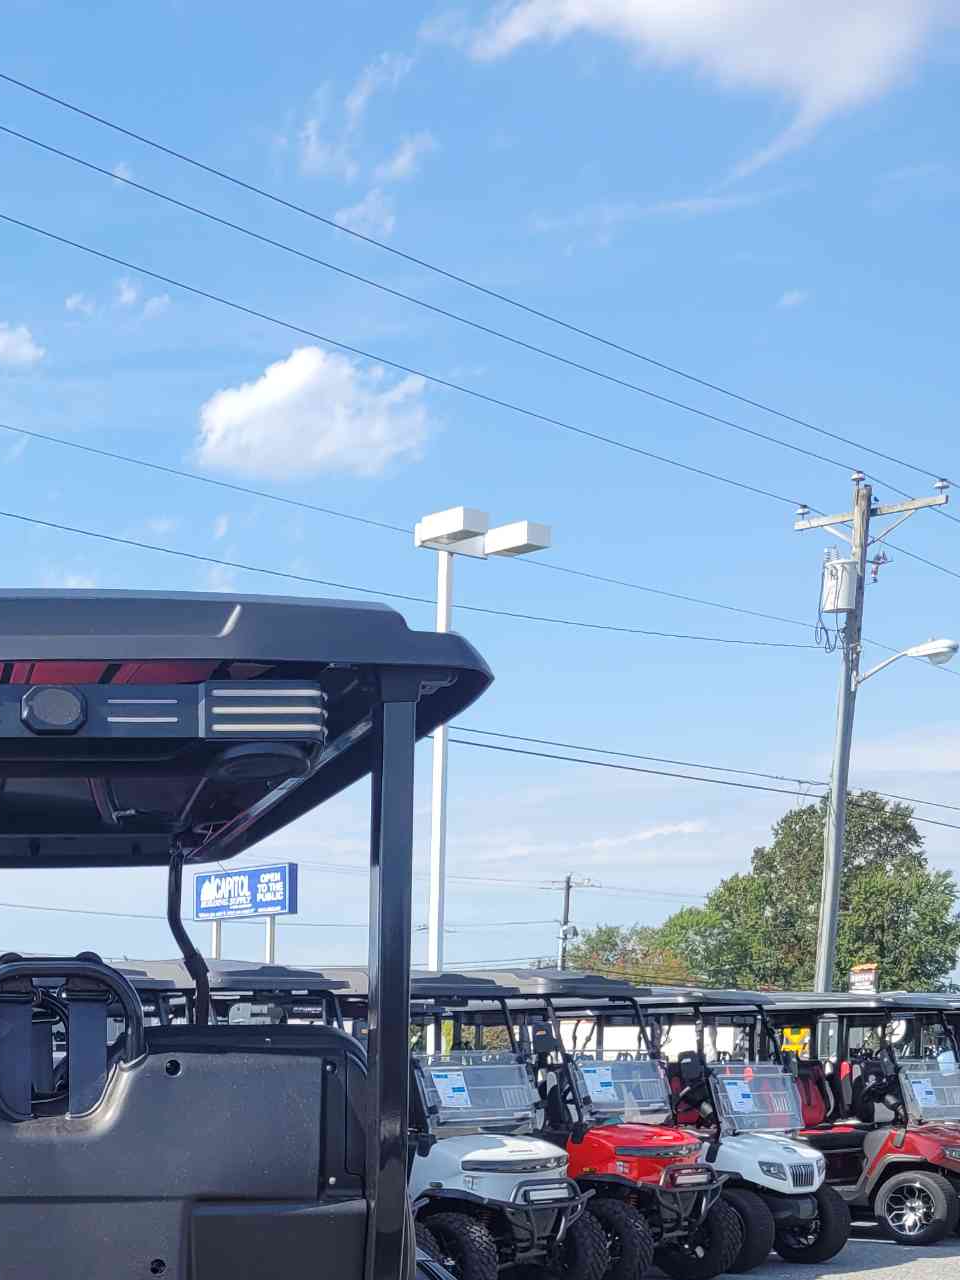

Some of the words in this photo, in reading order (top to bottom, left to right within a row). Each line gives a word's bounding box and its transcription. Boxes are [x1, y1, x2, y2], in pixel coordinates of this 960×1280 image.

[260, 873, 281, 883] OPEN
[216, 875, 250, 897] CAPITOL
[257, 883, 268, 893] TO
[269, 882, 284, 892] THE
[256, 891, 284, 902] PUBLIC
